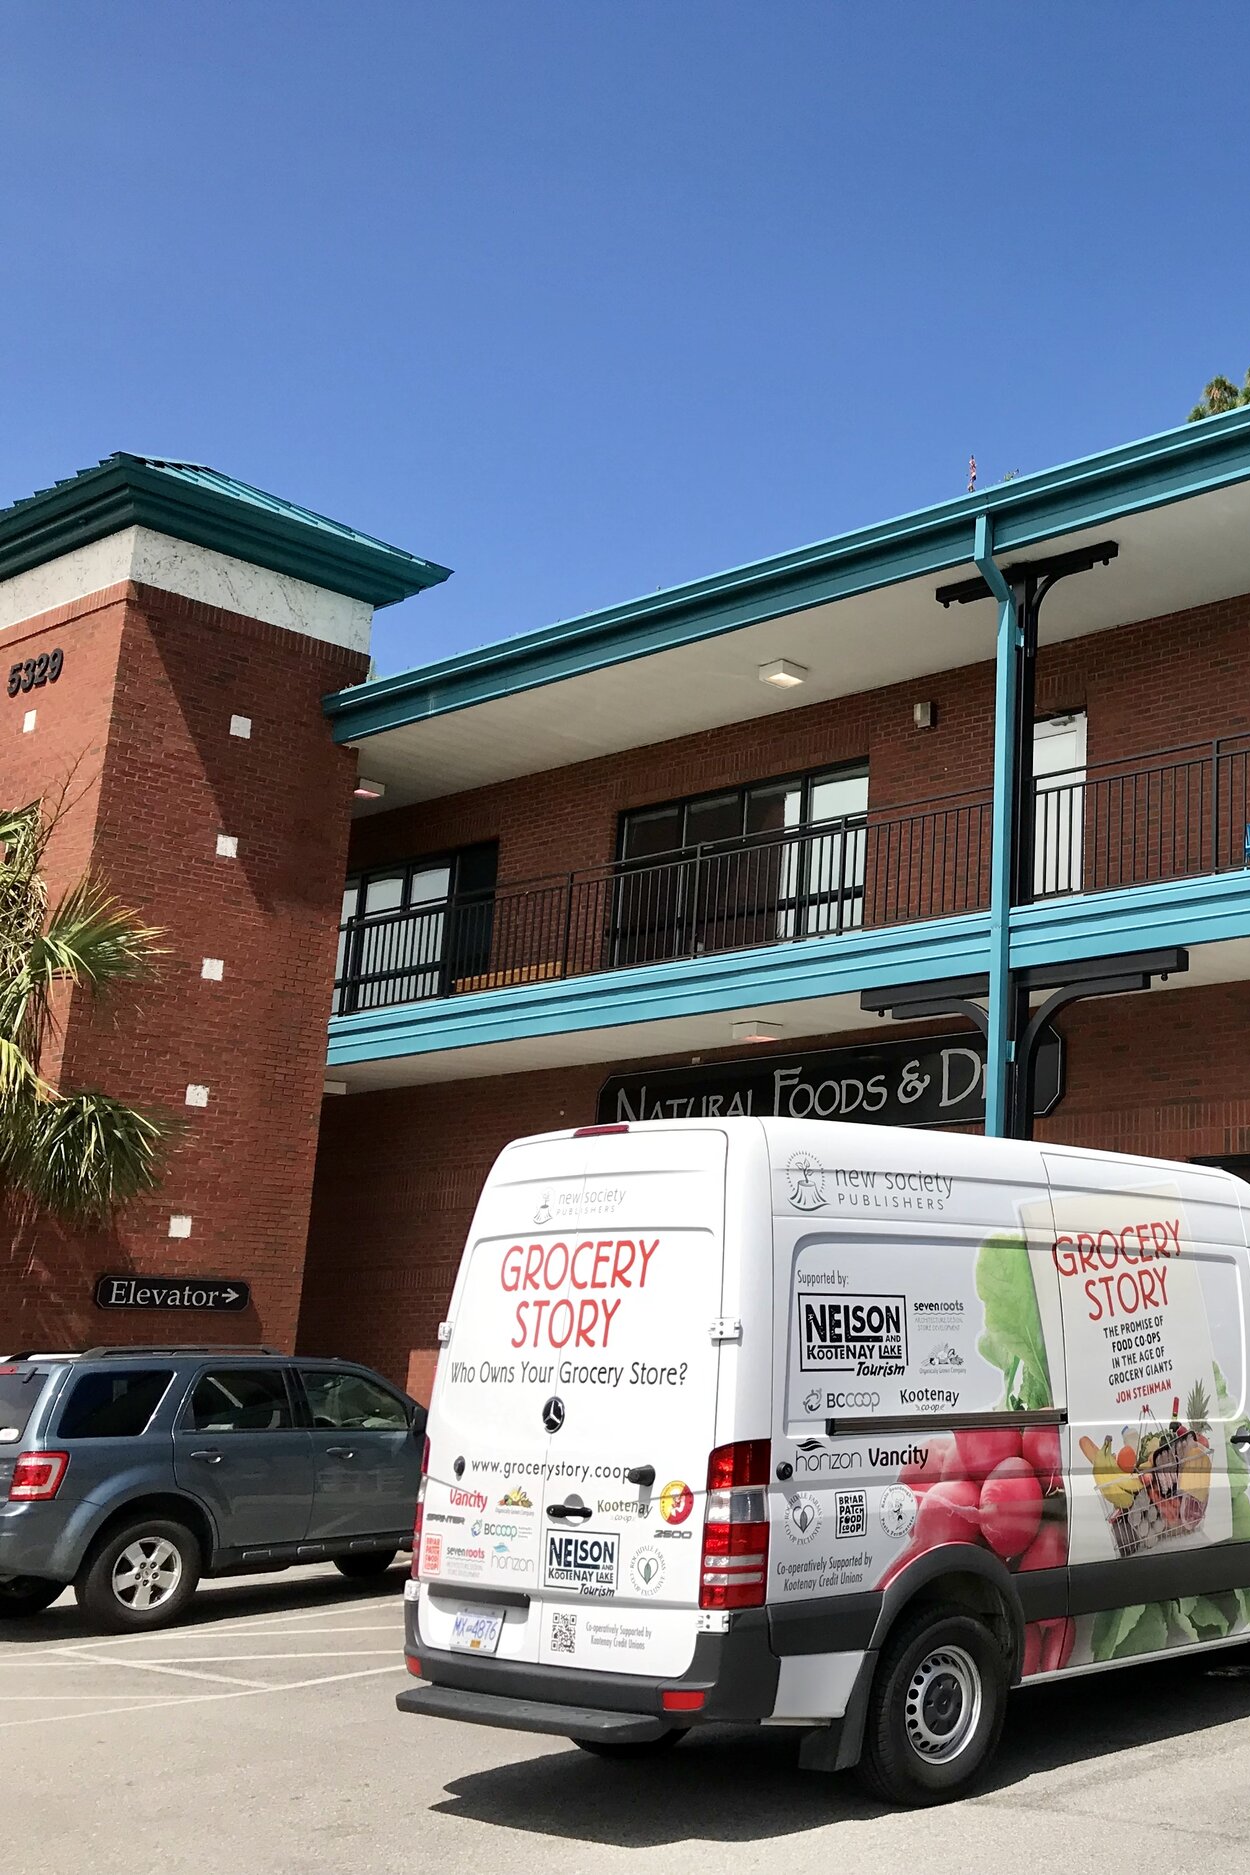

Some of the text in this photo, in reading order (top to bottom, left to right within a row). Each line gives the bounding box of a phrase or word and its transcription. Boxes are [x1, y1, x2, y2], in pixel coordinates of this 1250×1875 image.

[7, 648, 64, 697] 5329
[773, 1067, 886, 1117] FOODS
[897, 1060, 930, 1103] &
[835, 1167, 954, 1199] new society
[558, 1188, 627, 1206] new society
[838, 1193, 945, 1211] PUBLISHERS
[556, 1205, 616, 1216] PUBLISHERS
[1052, 1219, 1181, 1277] GROCERY
[501, 1239, 660, 1292] GROCERY
[797, 1269, 850, 1288] Supported by:
[109, 1281, 219, 1307] Elevator
[1084, 1266, 1169, 1321] STORY
[511, 1298, 621, 1348] STORY
[805, 1304, 901, 1343] NELSON
[1103, 1315, 1164, 1339] THE PROMISE OF
[885, 1335, 902, 1343] AND
[1111, 1331, 1161, 1353] FOOD CO-OPS
[807, 1344, 903, 1360] KOOTENAY LAKE
[1111, 1346, 1165, 1369] IN THE AGE OF
[451, 1361, 688, 1388] Who Owns Your Grocery Store?
[856, 1361, 906, 1378] Tourism
[1108, 1359, 1173, 1386] GROCERY GIANTS
[899, 1388, 960, 1407] Kootenay
[1116, 1379, 1172, 1404] JON STEINMAN
[795, 1443, 929, 1472] horizon Vancity
[471, 1459, 631, 1485] www.grocerystory.coop
[449, 1488, 488, 1513] Vancity
[597, 1499, 654, 1519] Kootenay
[838, 1495, 864, 1505] BRIAR
[839, 1504, 865, 1516] PATCH
[840, 1515, 862, 1525] FOOD
[653, 1529, 693, 1540] 2500
[549, 1537, 615, 1570] NELSON
[776, 1551, 873, 1576] Co-operatively Supported by
[548, 1568, 614, 1584] KOOTENAY LAKE
[783, 1572, 863, 1592] Kootenay Credit Unions
[579, 1582, 616, 1598] Tourism
[619, 1623, 645, 1638] Supported
